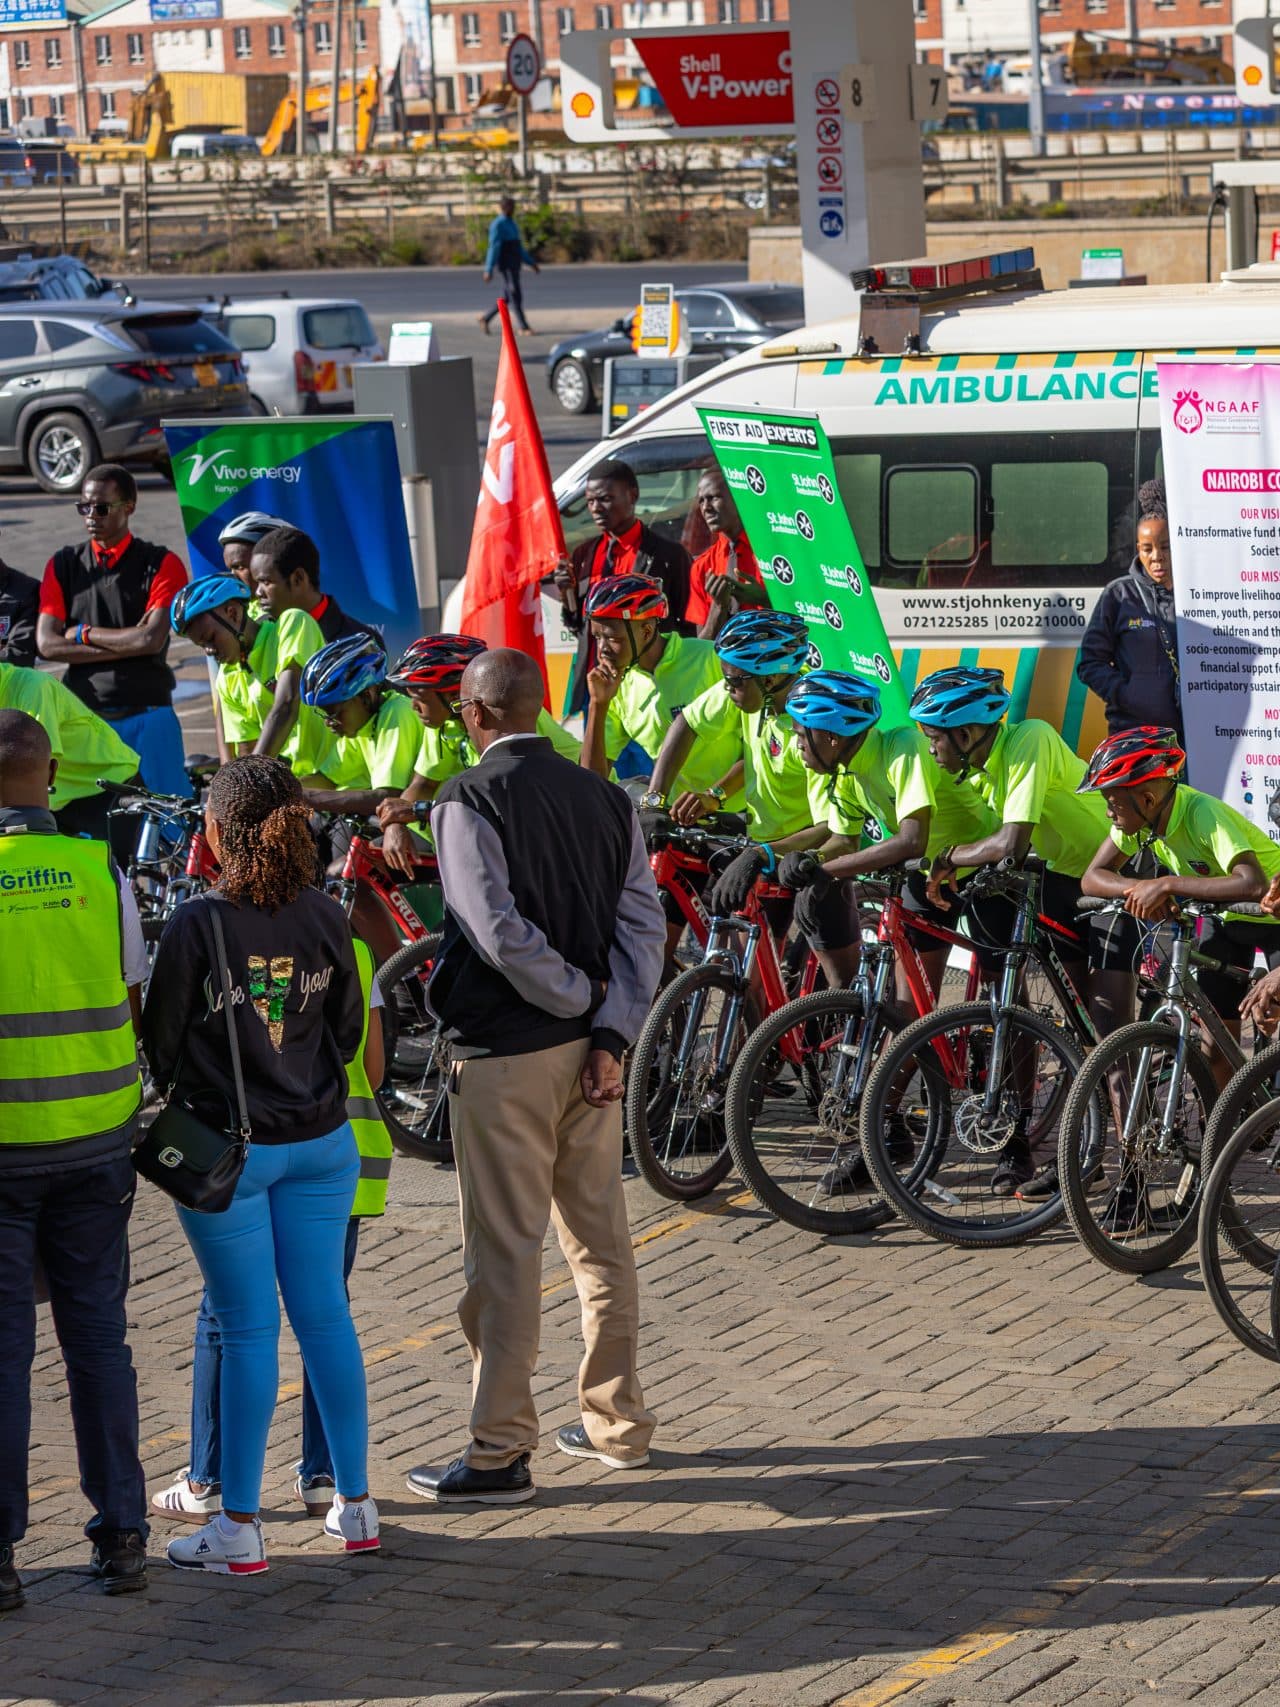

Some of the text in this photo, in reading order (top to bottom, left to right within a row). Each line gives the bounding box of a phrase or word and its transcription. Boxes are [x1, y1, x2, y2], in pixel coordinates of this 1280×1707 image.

[513, 54, 534, 76] 20
[680, 54, 721, 73] Shell
[681, 75, 790, 99] V-Power
[851, 78, 862, 107] 8
[930, 78, 941, 106] 7
[1205, 401, 1260, 413] NGAAF
[709, 420, 818, 446] FIRST AID EXPERTS
[212, 465, 301, 483] Vivo energy
[1207, 472, 1264, 490] NAIROBI
[1240, 508, 1259, 520] OUR
[1177, 526, 1183, 538] A
[1185, 526, 1252, 538] transformative
[1254, 526, 1276, 538] fund
[1240, 570, 1259, 583] OUR
[902, 594, 1086, 612] www.stjohnkenya.org
[1190, 588, 1200, 600] To
[1202, 589, 1240, 604] improve
[903, 615, 989, 628] 0721225285
[1183, 608, 1219, 620] women,
[1221, 607, 1251, 621] youth,
[1213, 626, 1250, 638] children
[1252, 626, 1269, 638] and
[1186, 644, 1257, 656] socio-economic
[1200, 661, 1240, 673] financial
[1242, 662, 1274, 677] suppot
[1188, 680, 1248, 694] participatory
[1215, 726, 1272, 741] Empowering
[1245, 754, 1264, 766] OUR
[0, 868, 73, 890] Griffin
[389, 891, 422, 931] CRUZ
